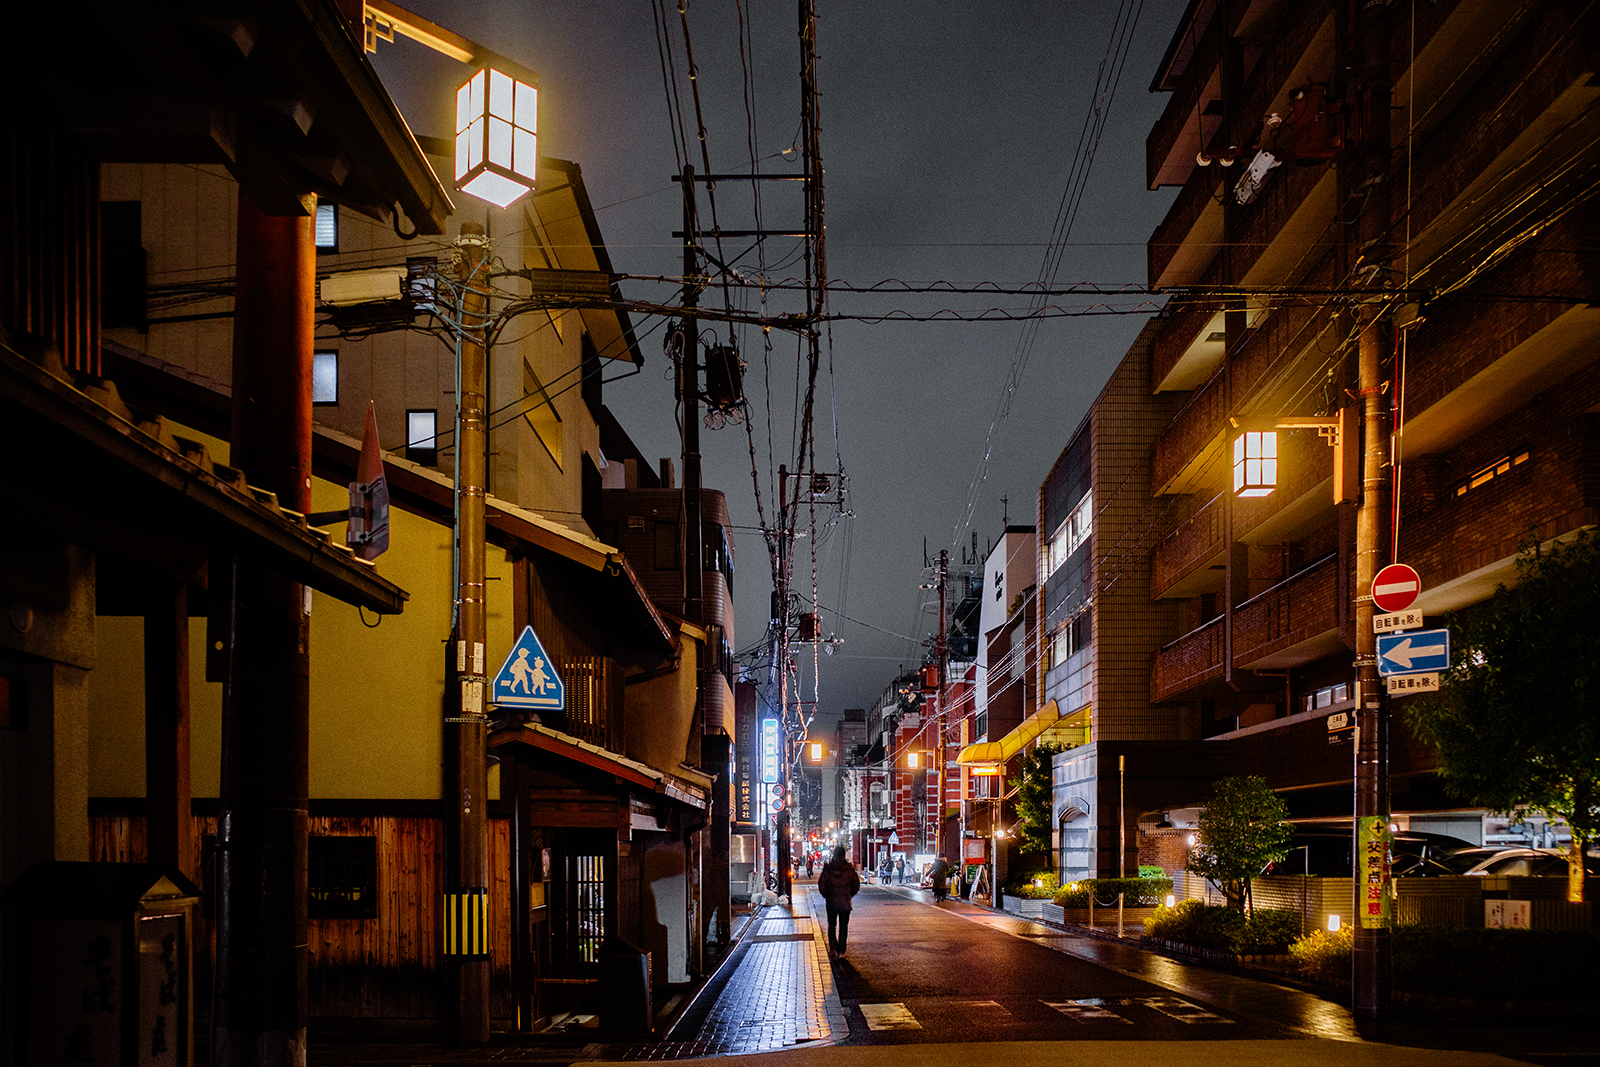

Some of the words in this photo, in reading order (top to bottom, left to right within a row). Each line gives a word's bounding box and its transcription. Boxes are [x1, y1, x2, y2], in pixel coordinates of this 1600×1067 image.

[1376, 614, 1421, 628] 自転車を除く
[1390, 677, 1436, 690] 自転車を除く
[1368, 841, 1381, 915] 交差点注意
